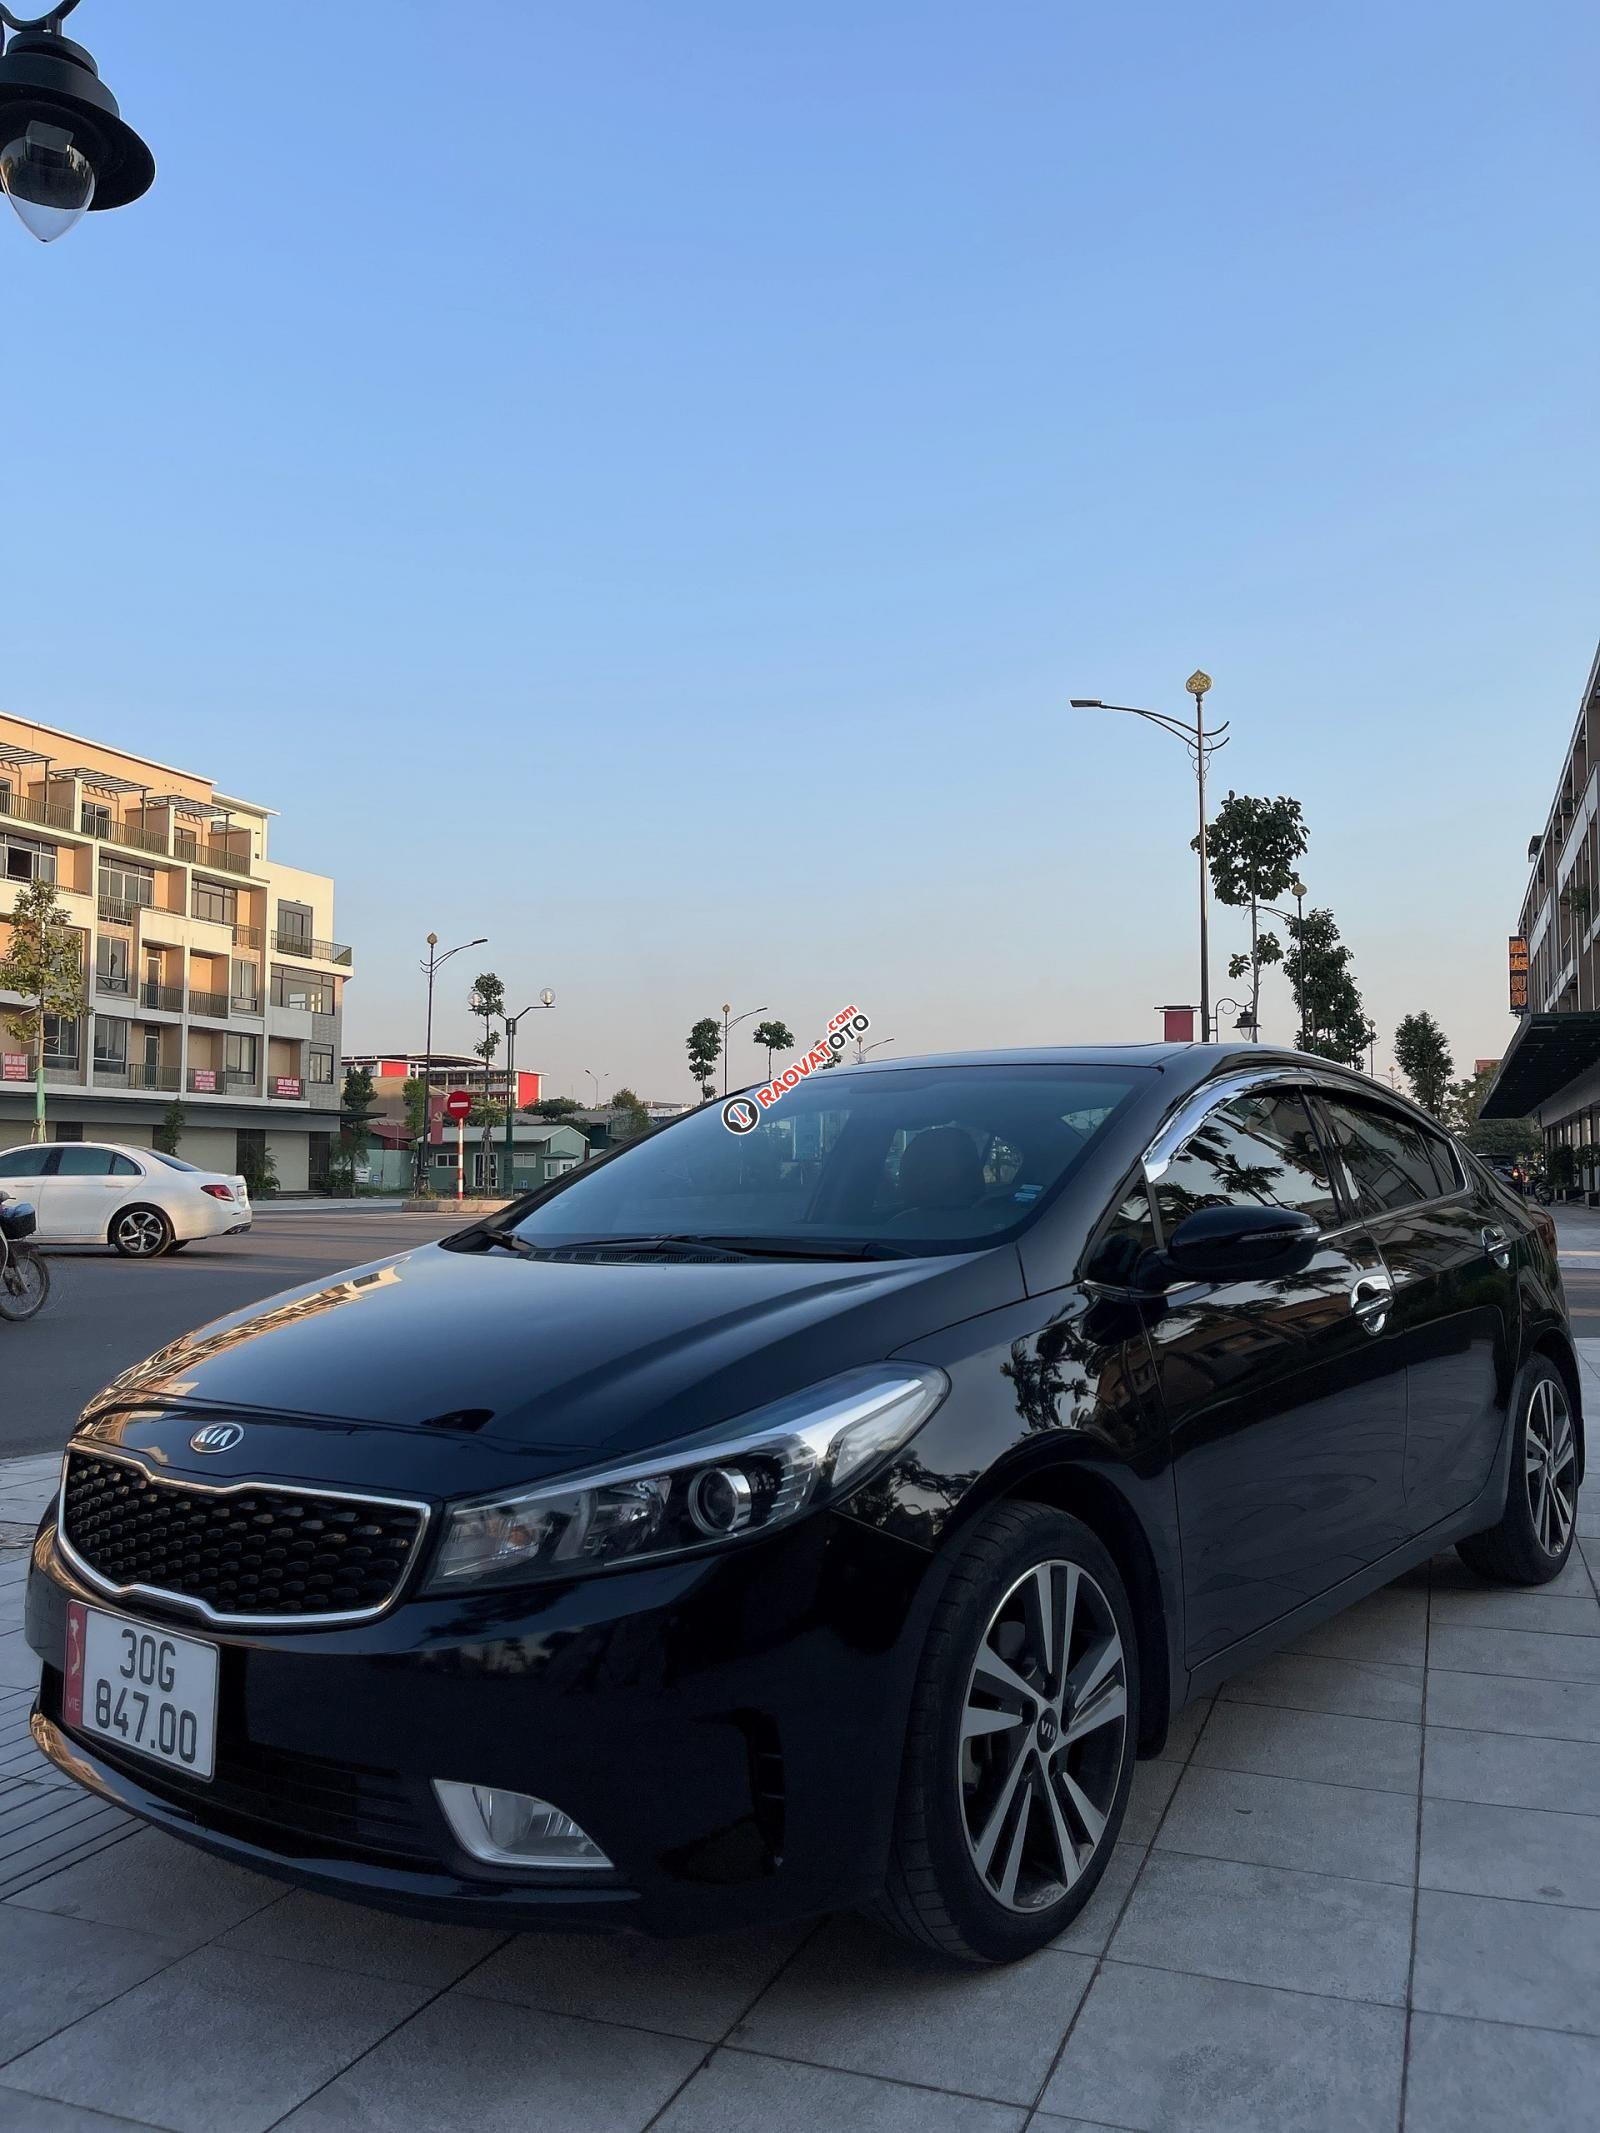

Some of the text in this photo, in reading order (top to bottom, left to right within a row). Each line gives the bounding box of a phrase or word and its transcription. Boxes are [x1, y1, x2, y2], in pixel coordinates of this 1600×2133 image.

[194, 1428, 234, 1447] KIA
[119, 1628, 176, 1693] 30G
[67, 1696, 80, 1712] VIE
[95, 1678, 197, 1764] 847.00
